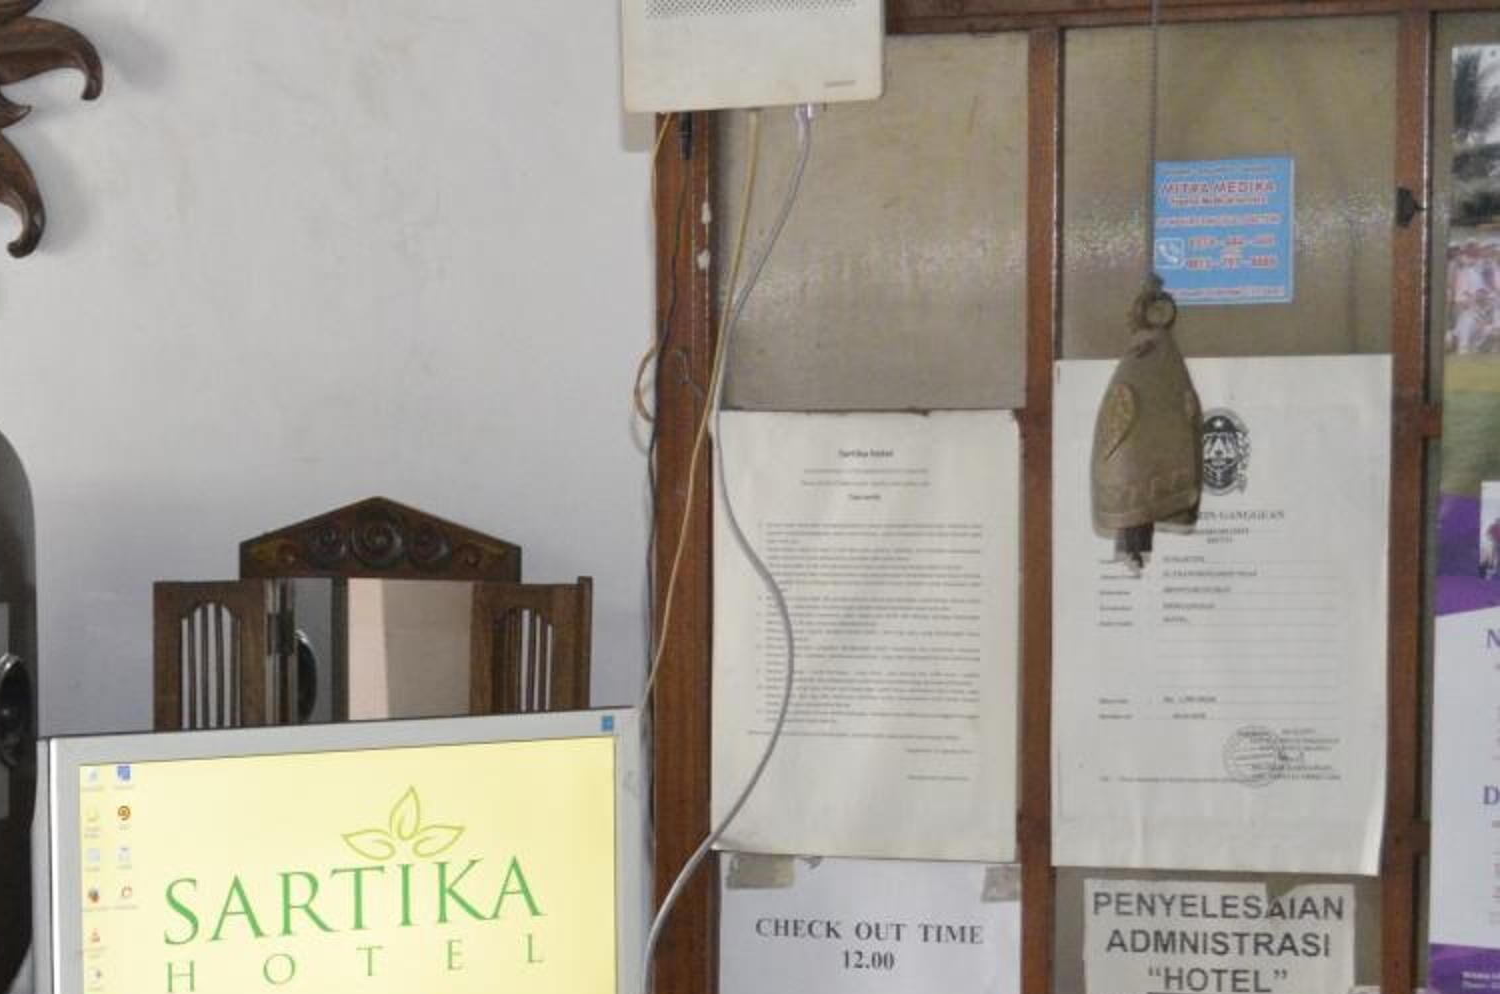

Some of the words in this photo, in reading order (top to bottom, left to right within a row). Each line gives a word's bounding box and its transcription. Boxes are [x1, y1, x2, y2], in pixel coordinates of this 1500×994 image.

[164, 855, 548, 945] SARTIKA
[1092, 891, 1344, 921] PENYELESAIAN
[755, 917, 842, 940] CHECK
[854, 921, 907, 942] OUT
[918, 923, 985, 945] TIME
[1105, 929, 1331, 957] ADMNISTRASI
[842, 949, 896, 970] 12.00
